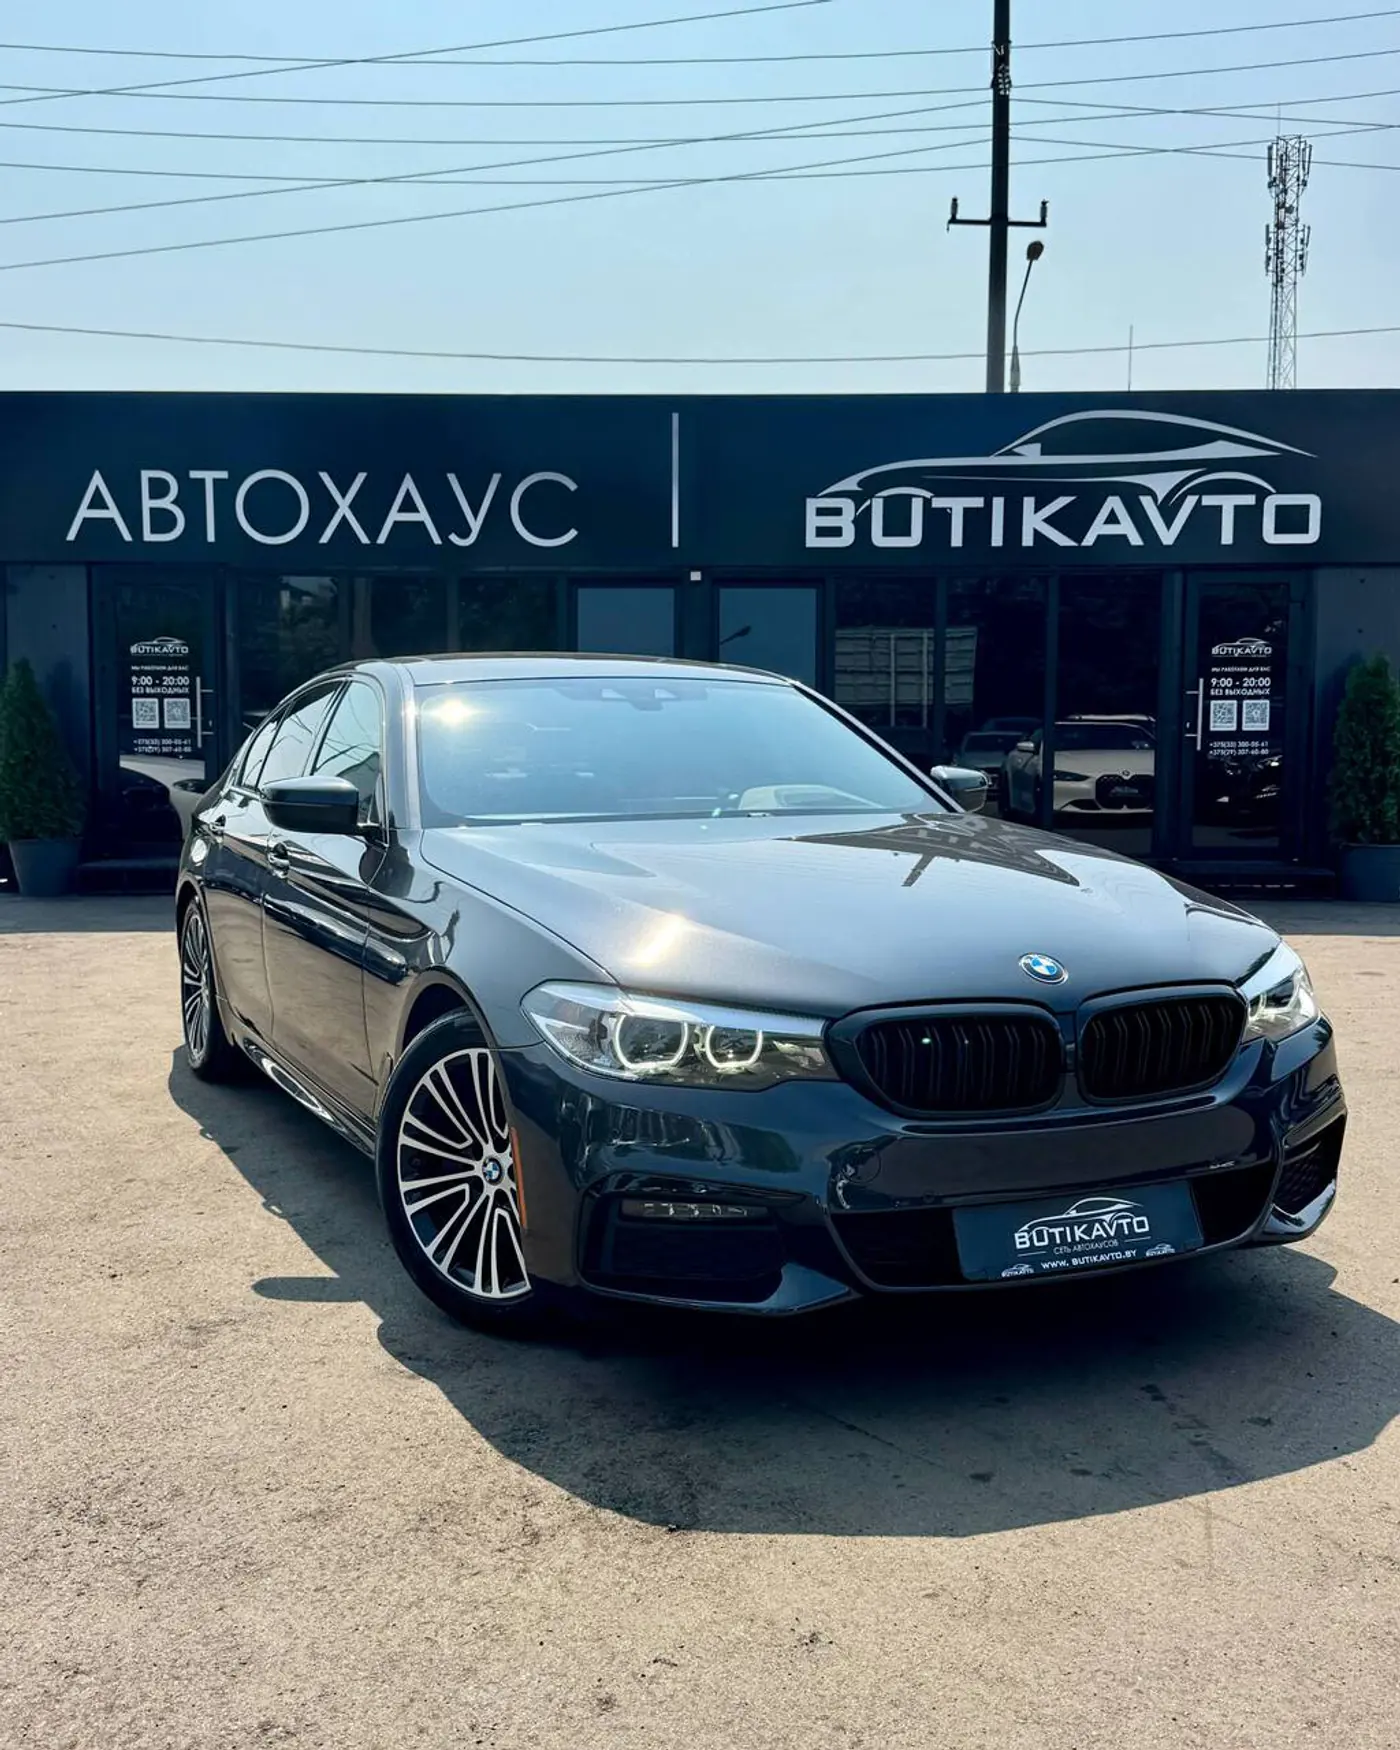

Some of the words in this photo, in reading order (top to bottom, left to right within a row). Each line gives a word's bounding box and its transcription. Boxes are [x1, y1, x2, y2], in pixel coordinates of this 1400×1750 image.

[66, 469, 578, 547] АВТОХАУС
[805, 493, 1322, 548] BUTIKAVTO
[1211, 646, 1272, 656] BUTIKAVTO
[131, 675, 153, 686] 9:00
[162, 675, 190, 686] 20:00
[1211, 677, 1233, 687] 9:00
[1242, 677, 1271, 687] 20:00
[131, 686, 144, 694] БЕЗ
[145, 686, 189, 695] ВЫХОДНЫХ
[1210, 688, 1223, 696] БЕЗ
[1225, 688, 1271, 696] ВЫХОДНЫХ
[1014, 1216, 1150, 1249] BUTIKAVTO
[1053, 1245, 1072, 1255] СЕТЬ
[1072, 1239, 1119, 1253] АВТОХАУСОВ
